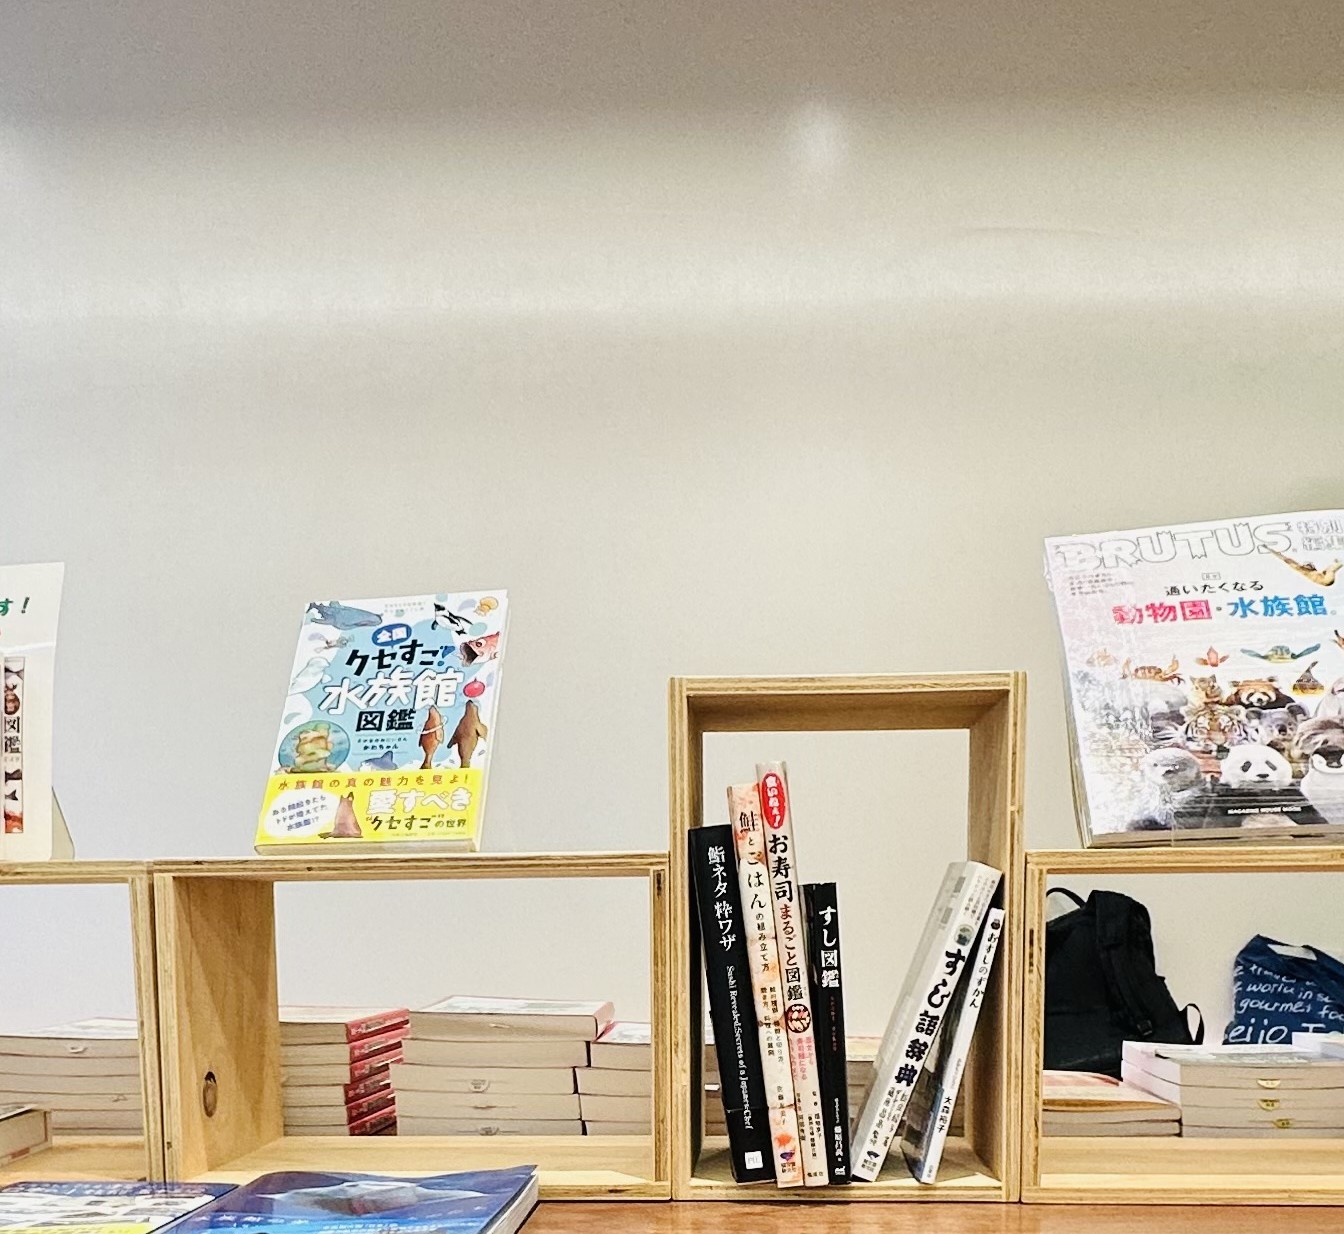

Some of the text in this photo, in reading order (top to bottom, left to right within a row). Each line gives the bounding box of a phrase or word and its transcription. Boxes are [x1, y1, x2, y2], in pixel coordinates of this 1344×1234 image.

[1056, 522, 1292, 571] BRUTUS
[1164, 581, 1264, 597] 通いたくなる
[318, 665, 464, 715] 水族館
[356, 708, 416, 732] 図鑑
[366, 786, 472, 815] 愛すべき
[739, 810, 770, 973] 鮭とごはんの組み立て方
[768, 833, 805, 1002] お寿司まるごと図鑑
[819, 905, 841, 989] すし図鑑
[969, 931, 999, 1009] おすしのずかん
[894, 948, 966, 1088] すし語辞典
[1298, 988, 1314, 1000] in
